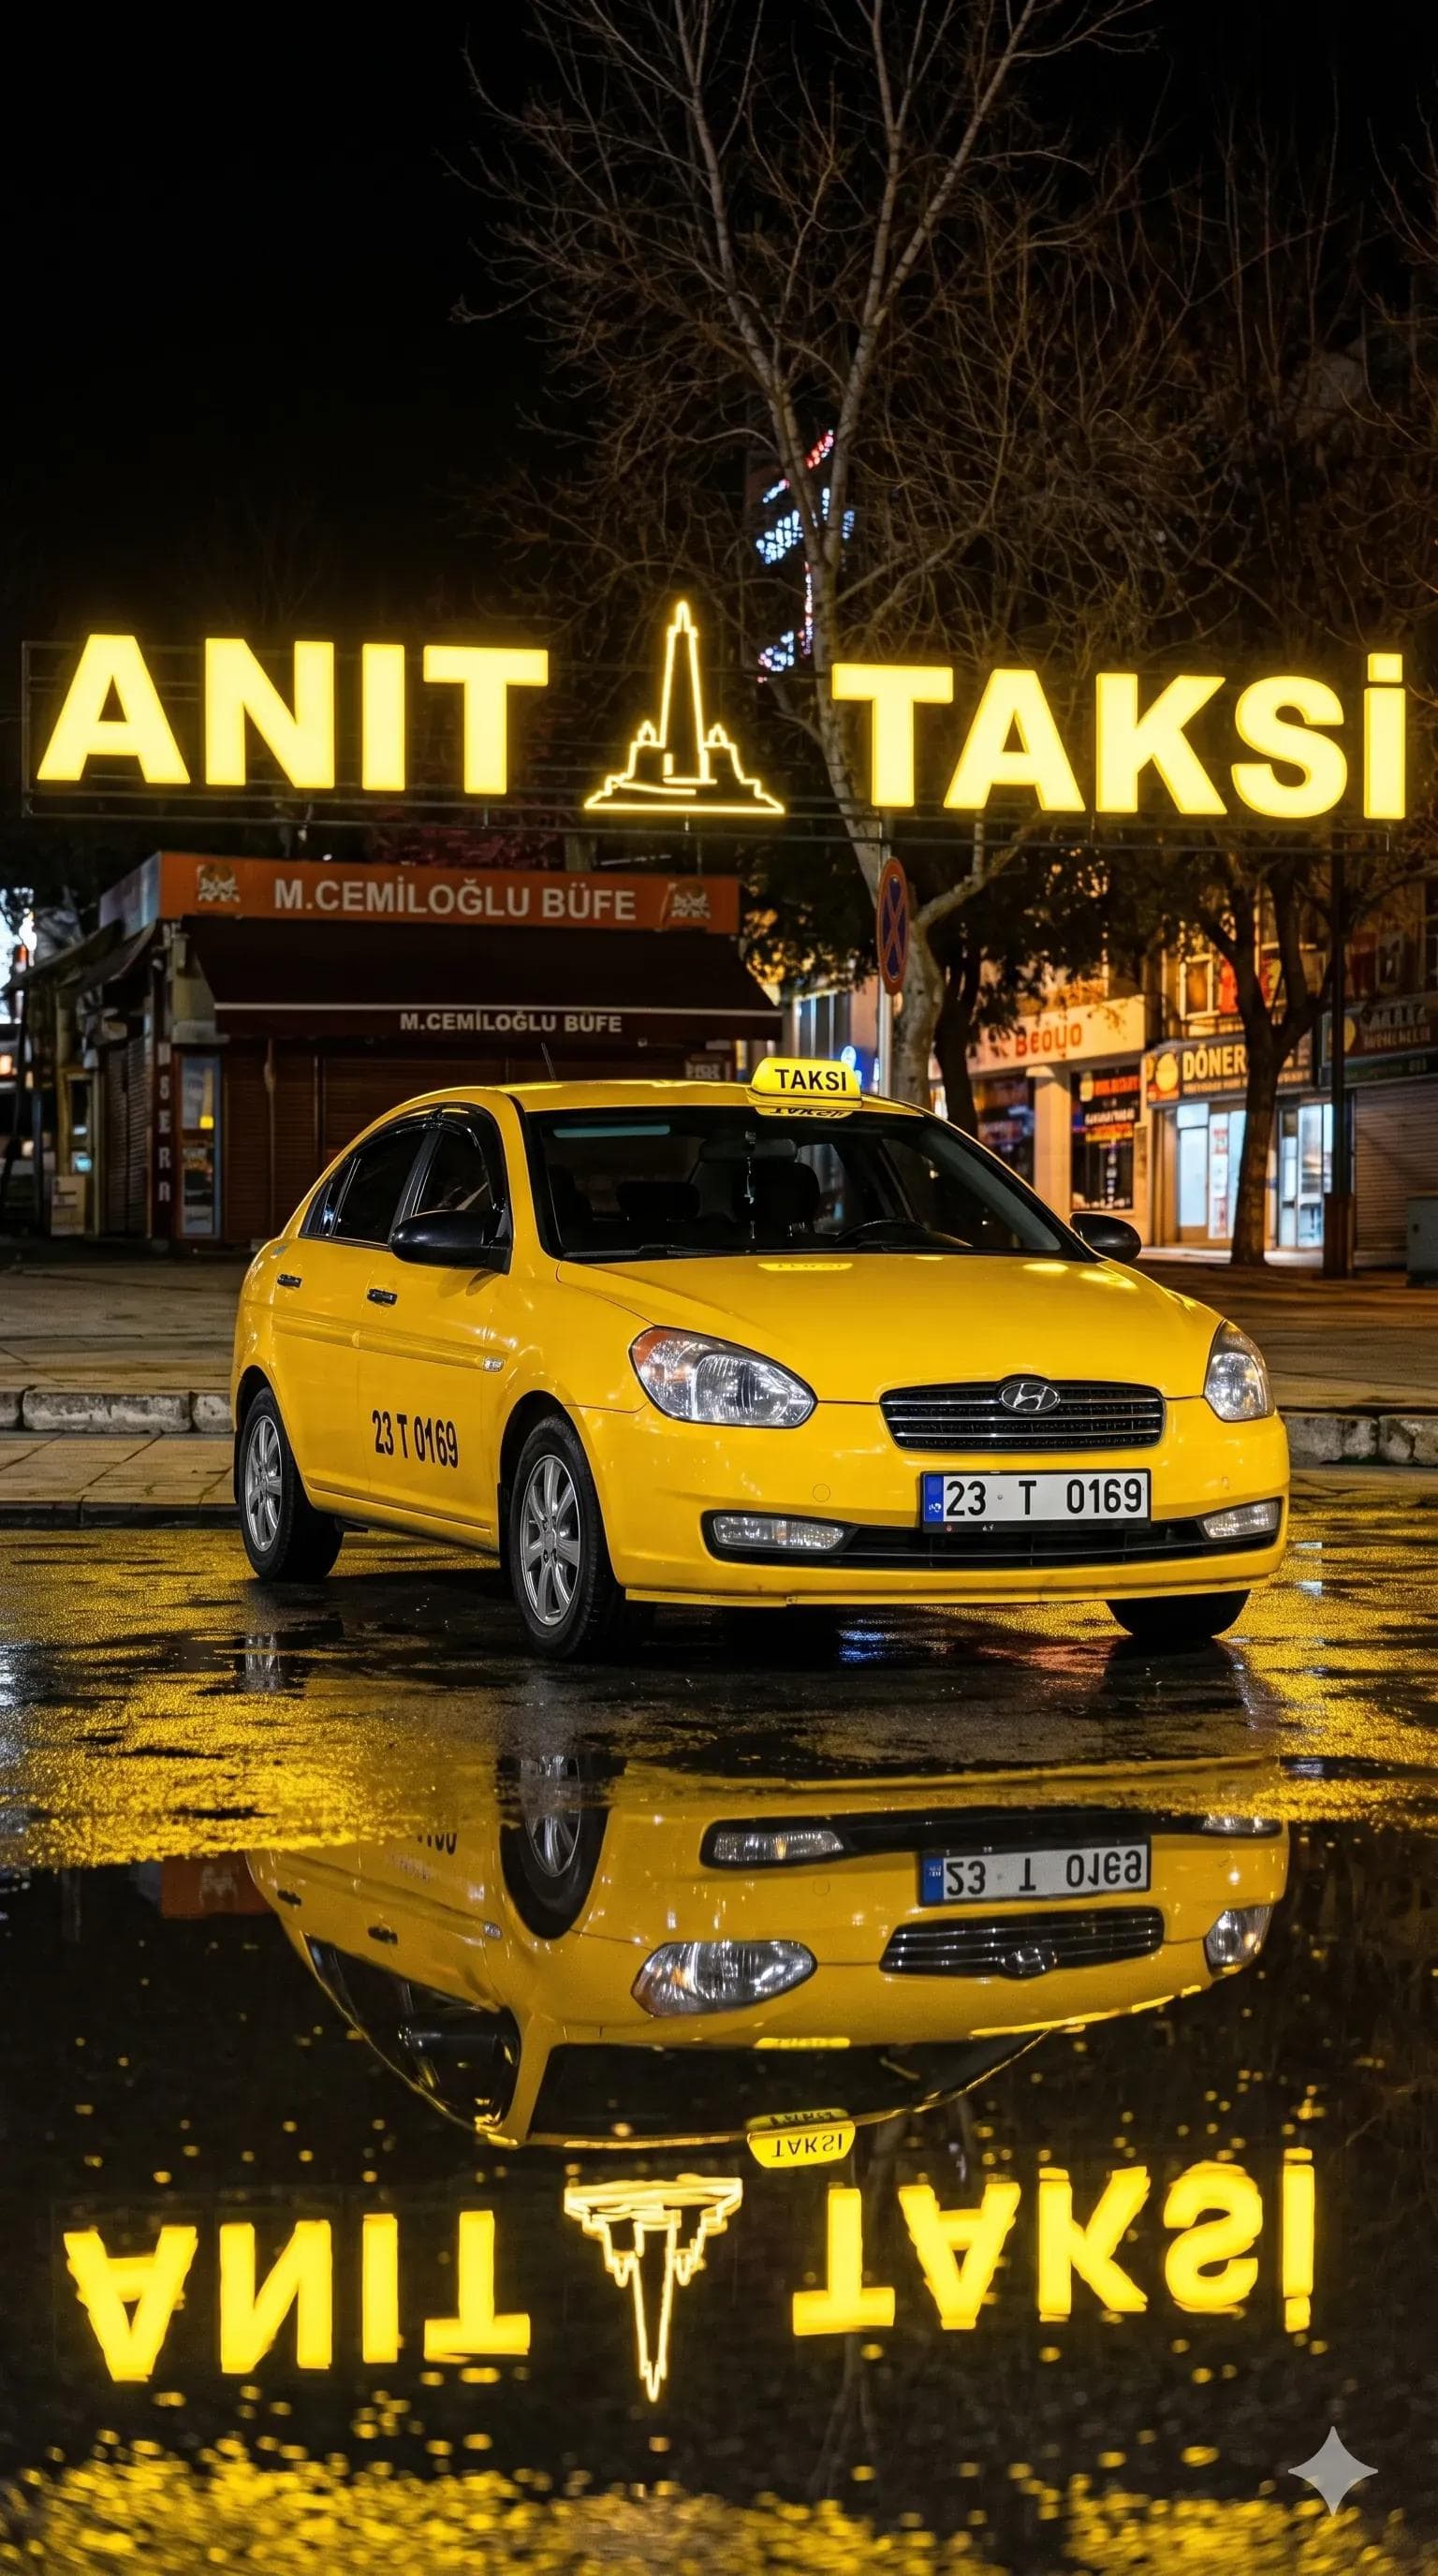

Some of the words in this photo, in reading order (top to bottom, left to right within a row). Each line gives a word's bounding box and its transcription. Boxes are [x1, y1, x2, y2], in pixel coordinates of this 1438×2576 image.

[37, 634, 549, 795] ANIT
[274, 876, 529, 916] M.CEMİLOĞLU
[542, 886, 637, 920] BÜFE
[400, 1009, 557, 1032] M.CEMİLOĞLU
[565, 1012, 622, 1033] BÜFE
[775, 1068, 847, 1091] TAKSI
[372, 1410, 394, 1456] 23
[396, 1413, 408, 1459] T
[414, 1416, 459, 1469] 0169
[946, 1480, 987, 1517] 23
[1019, 1480, 1037, 1515] T
[1066, 1477, 1142, 1515] 0169
